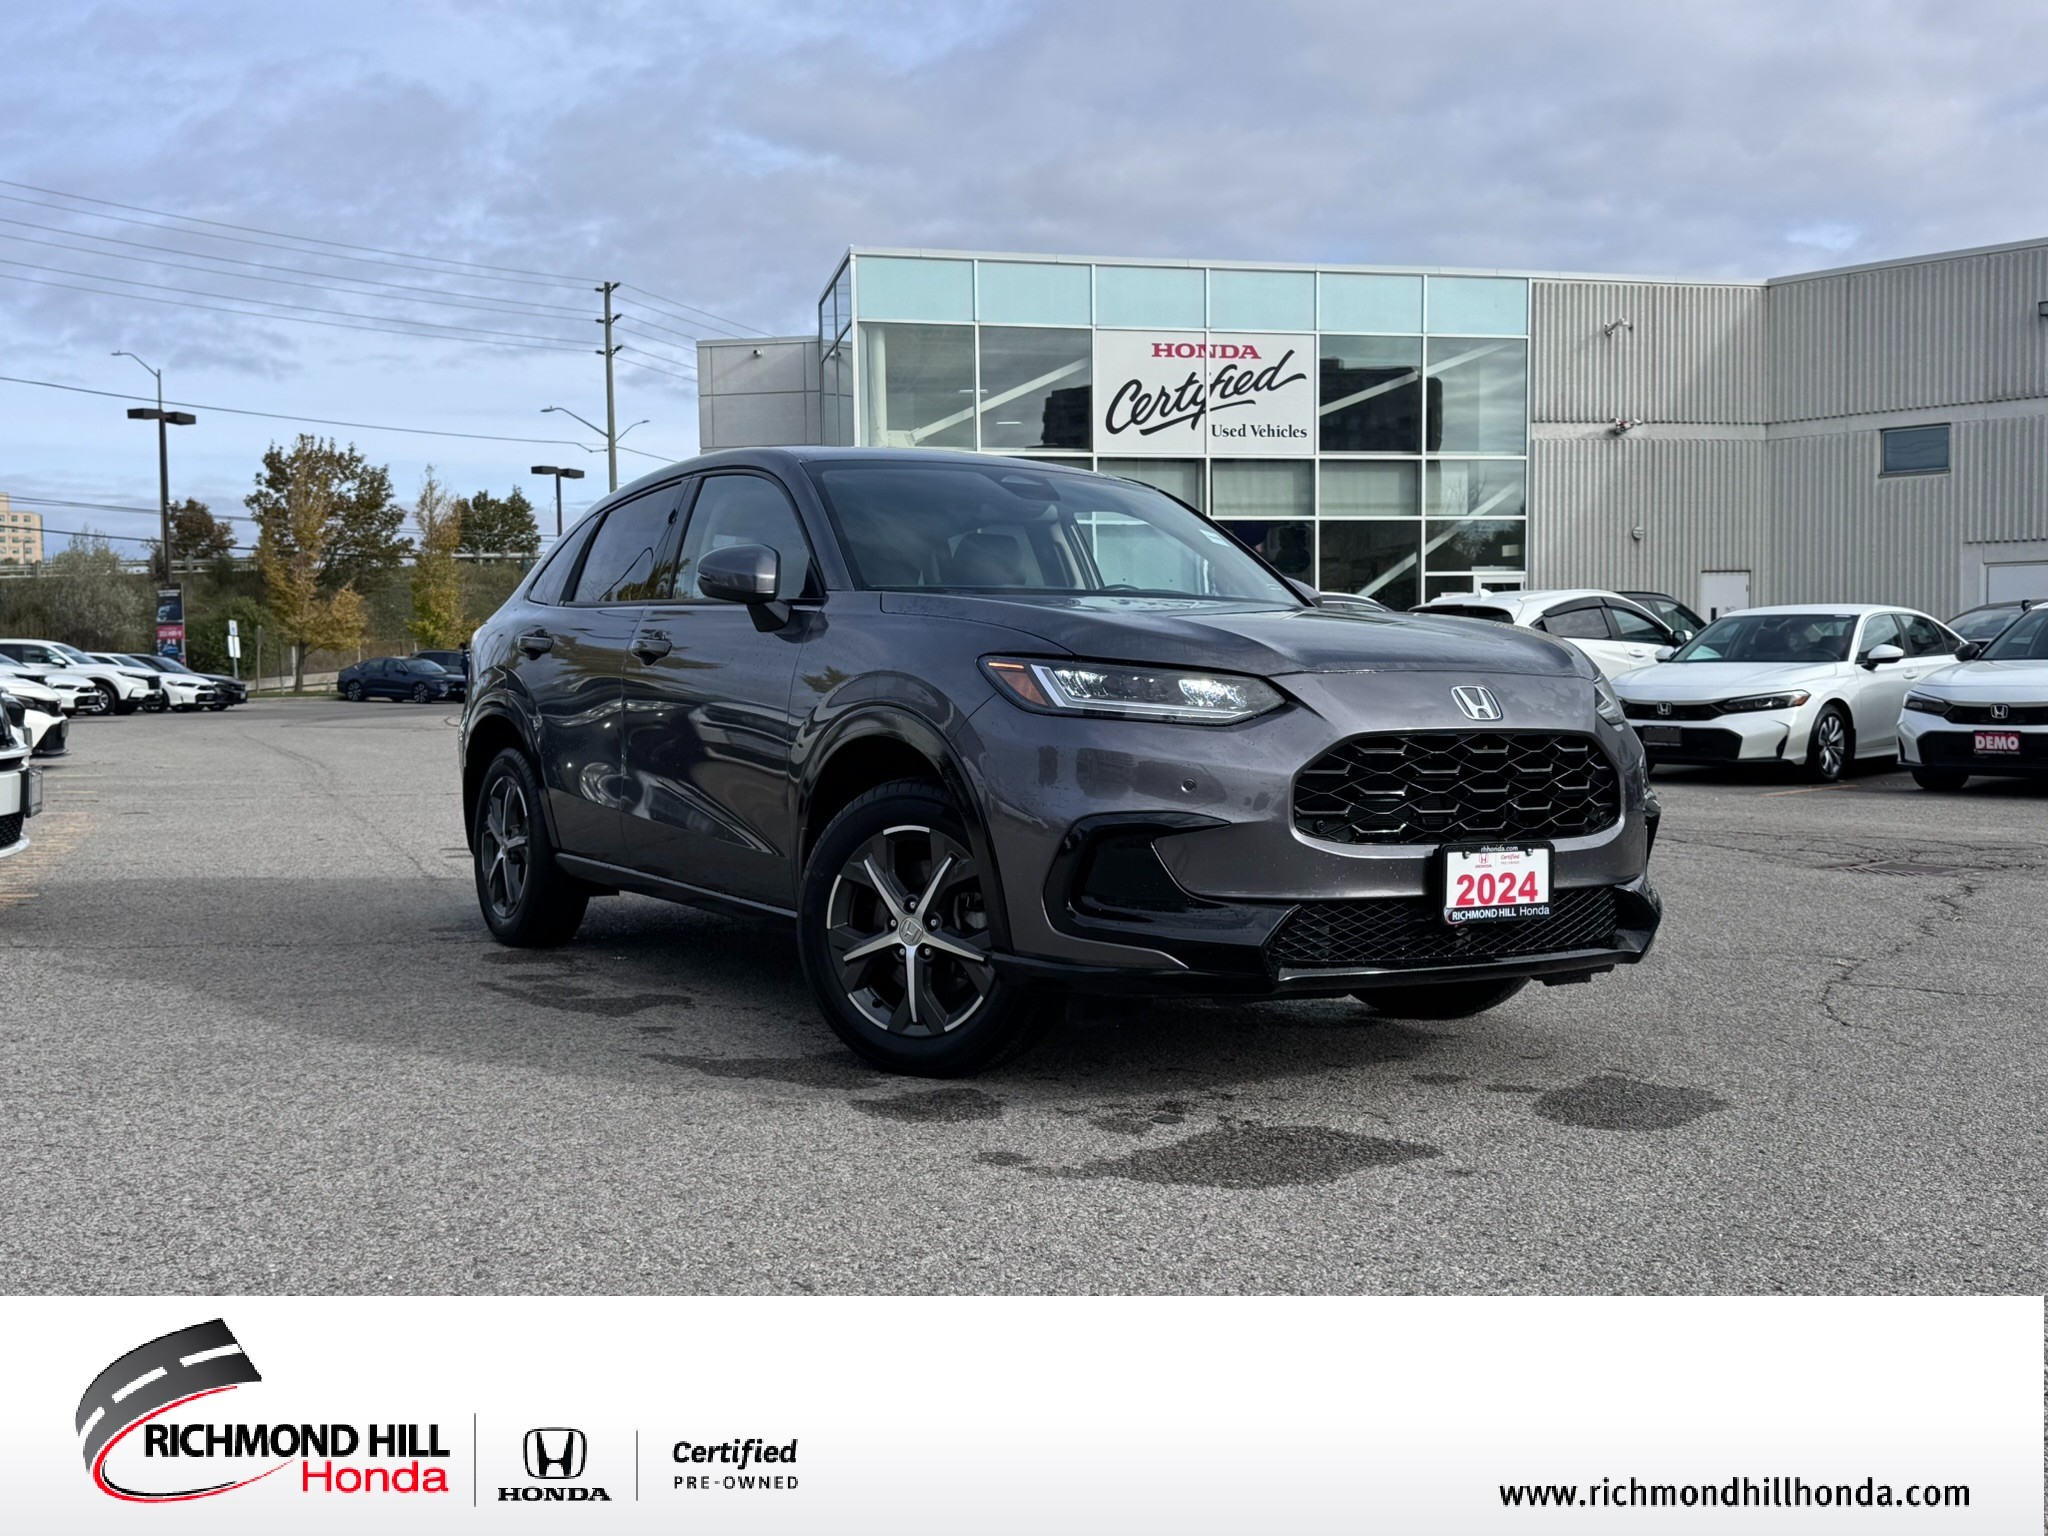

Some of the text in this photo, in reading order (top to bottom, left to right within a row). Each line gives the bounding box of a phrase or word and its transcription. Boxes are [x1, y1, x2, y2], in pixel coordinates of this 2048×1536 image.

[1151, 343, 1262, 359] HONDA
[1105, 350, 1307, 435] Certified
[1211, 424, 1308, 438] Used Vehicles
[1974, 735, 2019, 751] DEMO
[1456, 871, 1538, 906] 2024
[1452, 905, 1550, 921] RICHMOND HILL Honda
